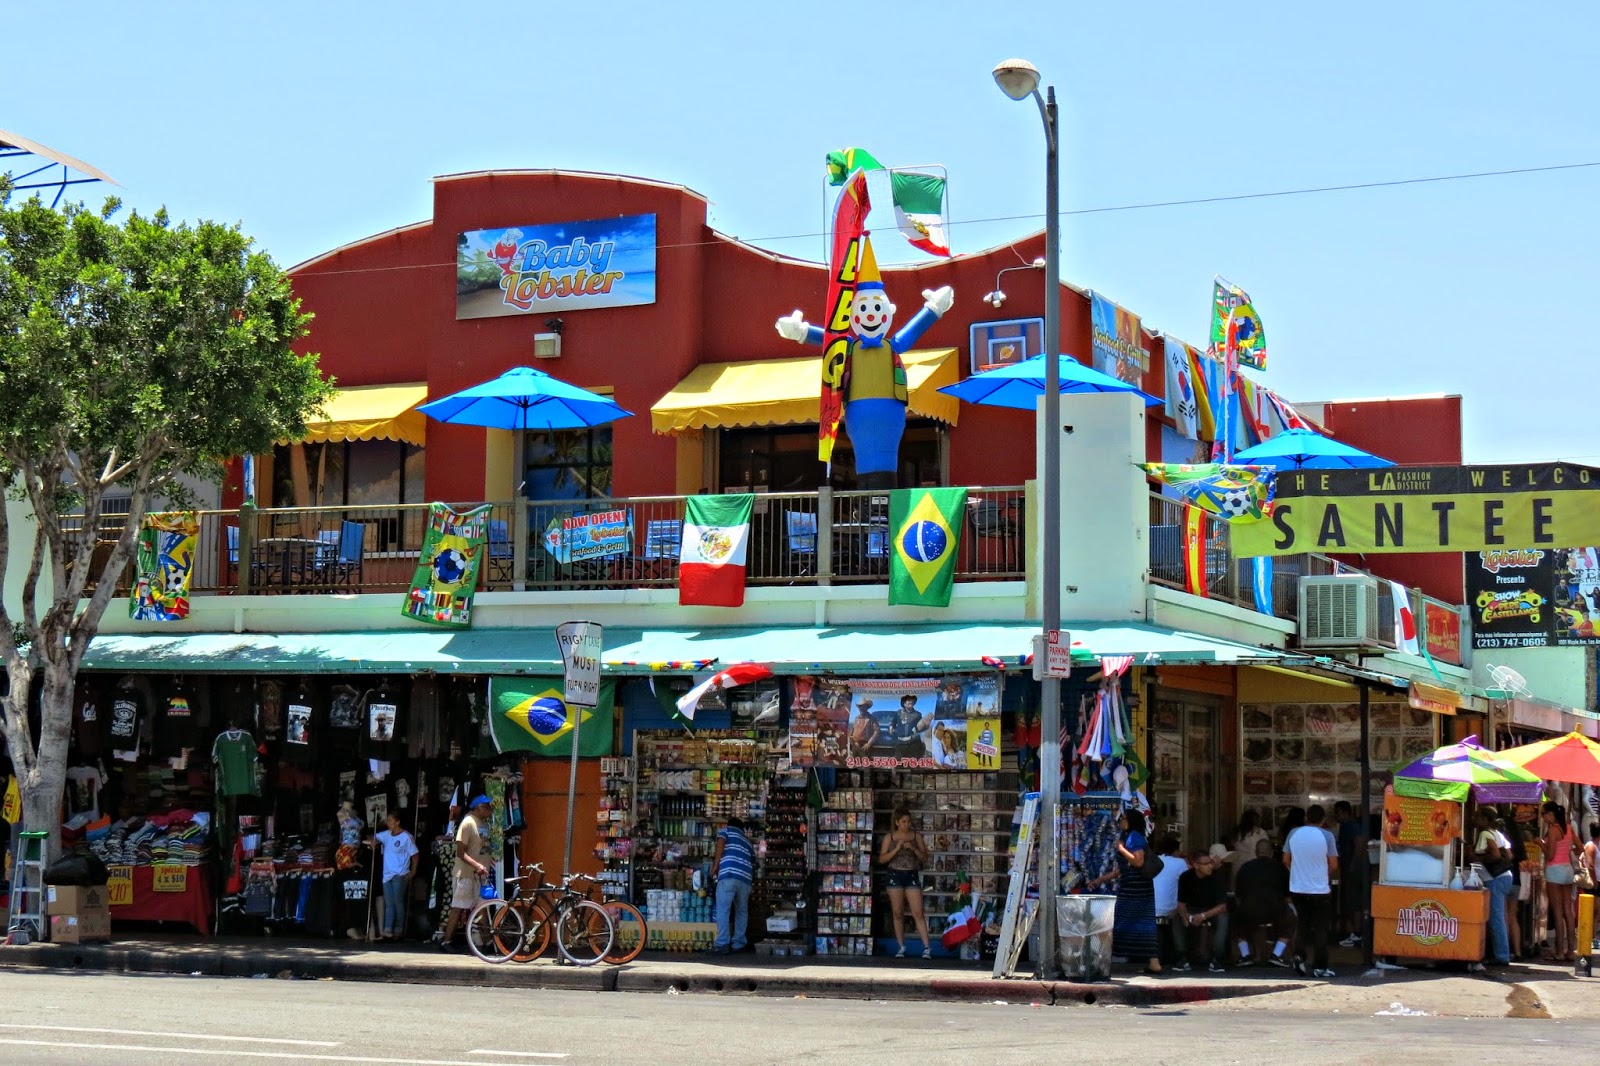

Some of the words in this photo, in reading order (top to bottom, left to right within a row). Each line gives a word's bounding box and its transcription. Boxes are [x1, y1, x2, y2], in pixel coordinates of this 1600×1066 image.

[518, 236, 613, 274] Baby
[500, 271, 624, 311] Lobster
[1369, 473, 1396, 491] LA
[1397, 472, 1431, 481] FASHION
[1471, 467, 1590, 487] WELCO
[1397, 481, 1430, 491] DISTRICT
[563, 515, 589, 530] NOW
[591, 510, 626, 526] OPEN!
[1273, 498, 1554, 550] SANTEE
[1496, 576, 1525, 584] Presenta
[1494, 590, 1520, 601] SHOW
[1498, 601, 1519, 610] PEPE
[1486, 607, 1539, 619] CASTELLANOS
[1477, 638, 1500, 648] (213)
[1502, 637, 1547, 647] 747-0605
[1050, 647, 1069, 657] PARKING
[573, 656, 596, 671] MUST
[567, 680, 582, 692] TURN
[584, 682, 598, 694] RIGHT
[846, 757, 934, 769] 213-550-7848
[109, 868, 131, 880] ECIAL
[171, 875, 185, 884] $10
[1396, 908, 1430, 940] Alley
[1430, 910, 1458, 942] Dog
